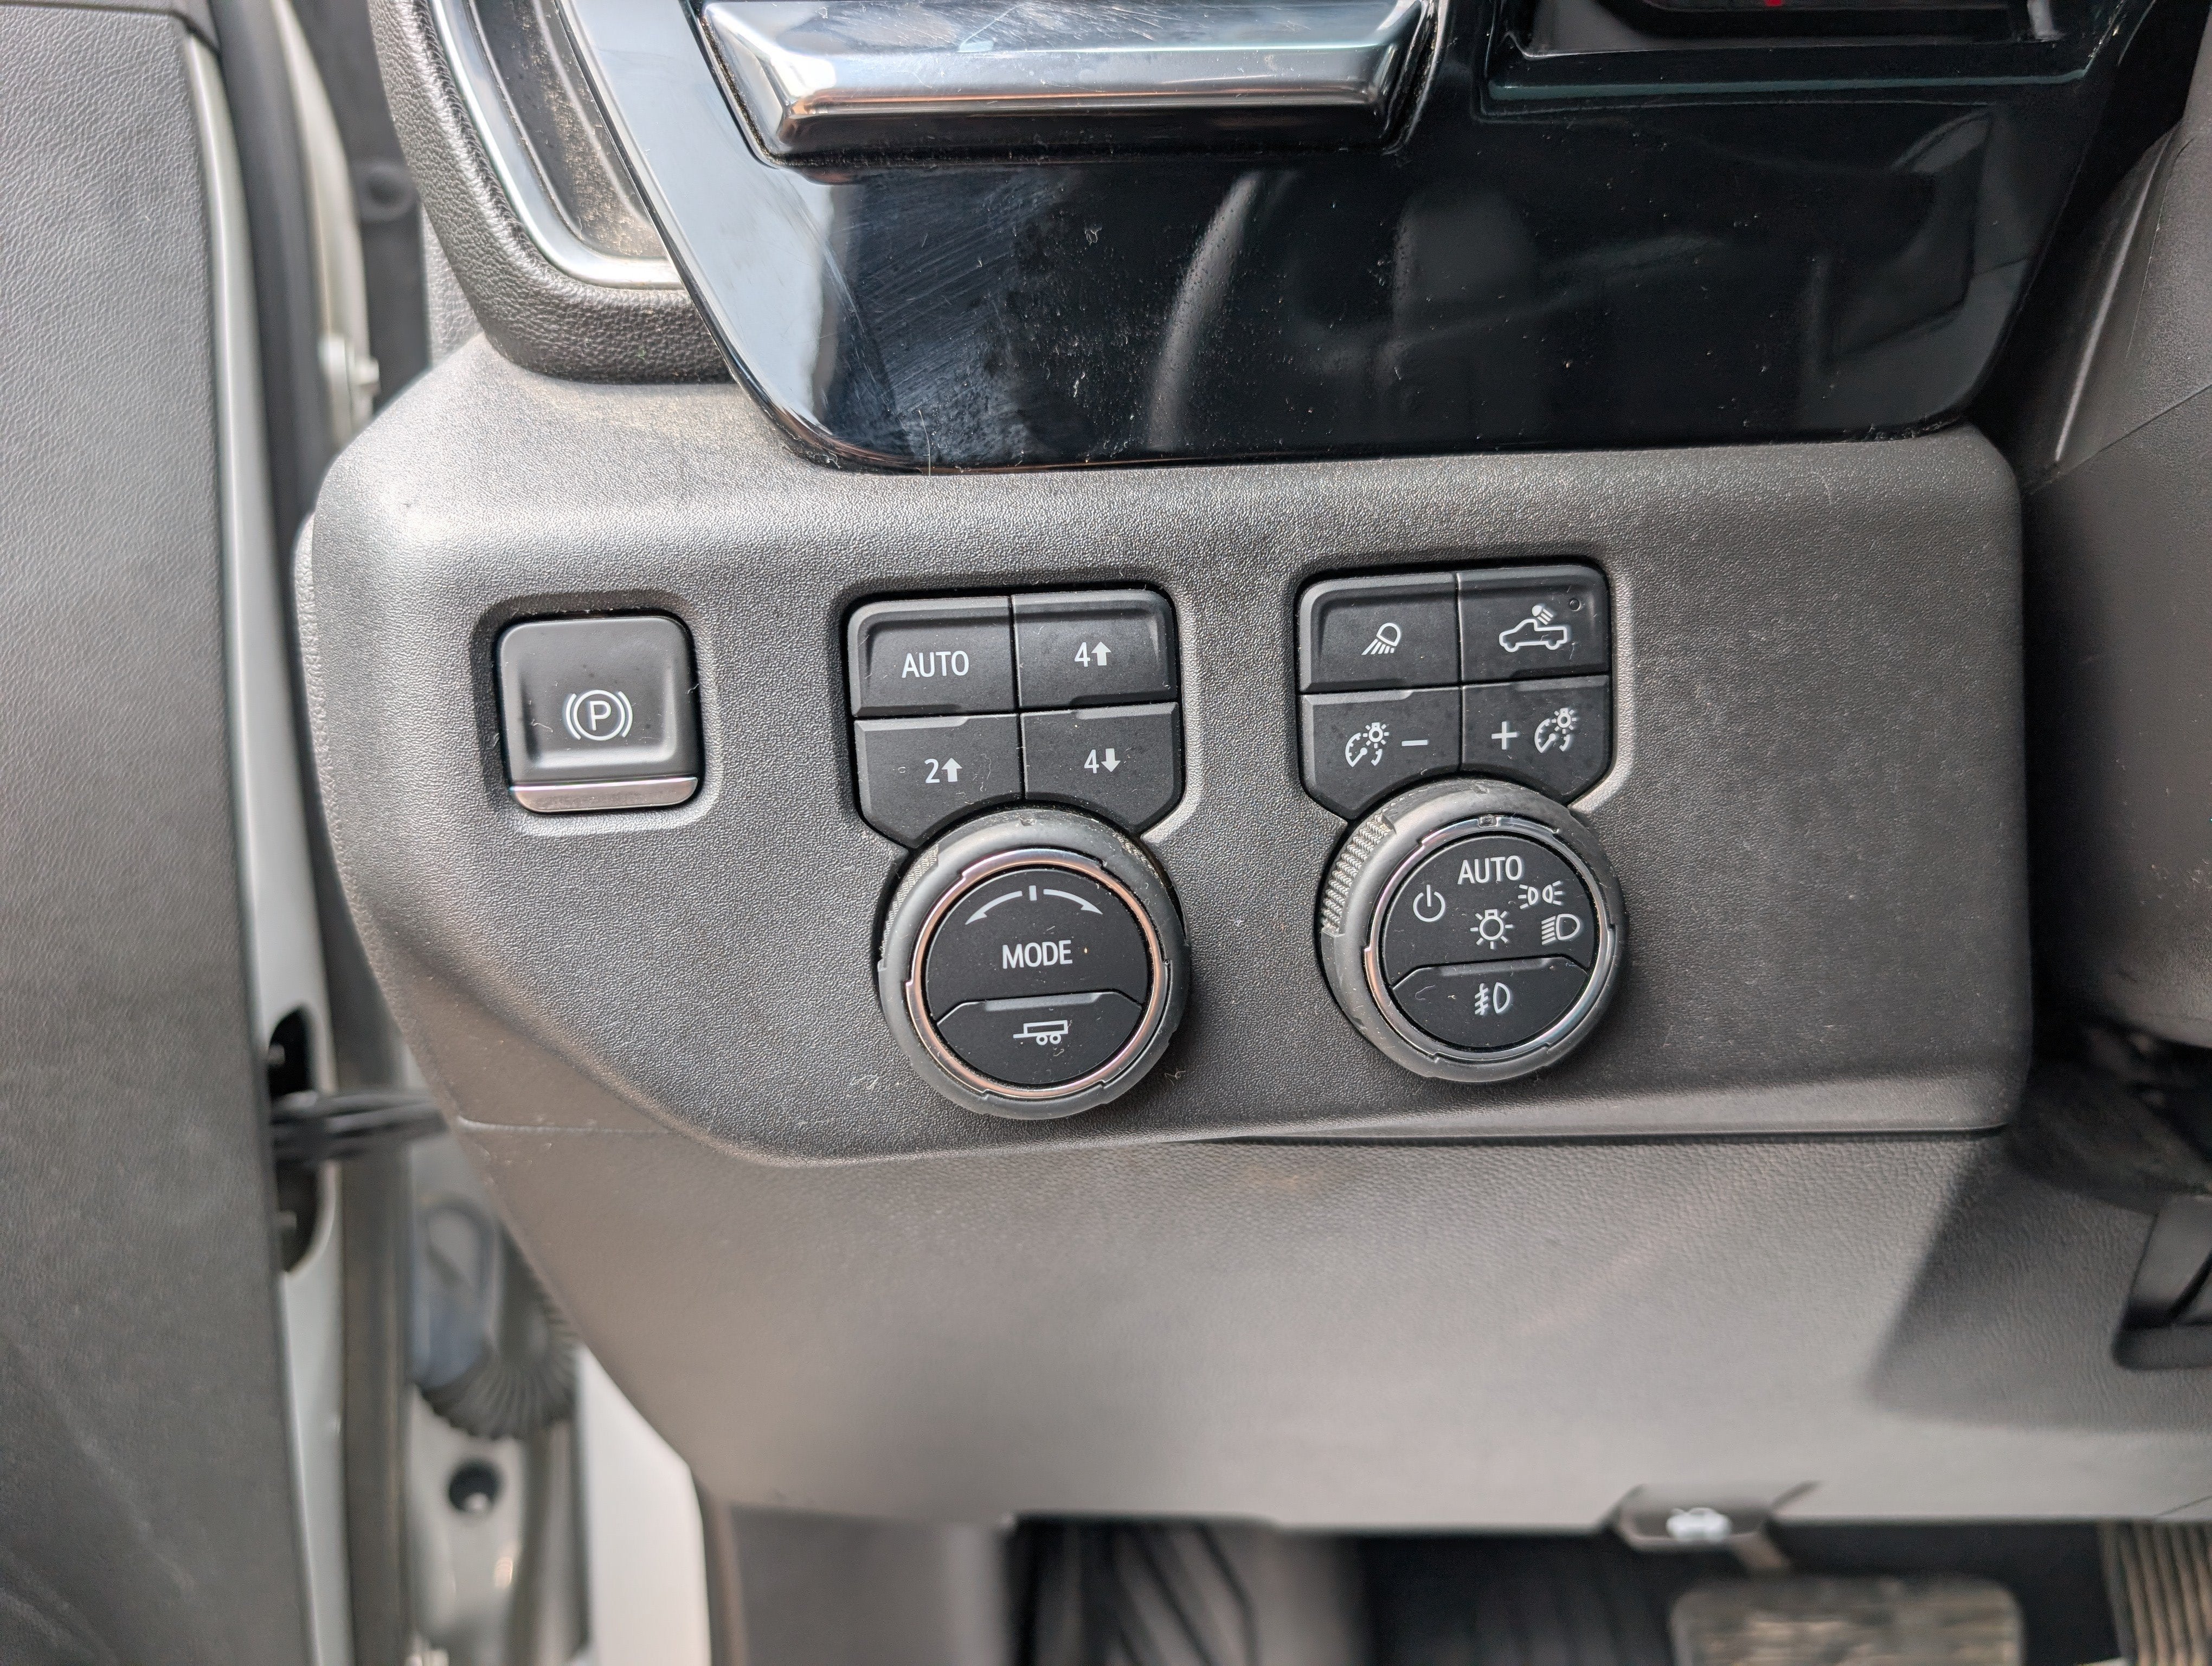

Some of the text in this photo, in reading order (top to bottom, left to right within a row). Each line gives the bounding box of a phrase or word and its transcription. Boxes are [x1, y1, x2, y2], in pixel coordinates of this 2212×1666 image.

[901, 651, 969, 678] AUTO
[1074, 642, 1091, 667] 4
[589, 700, 612, 731] P
[924, 758, 941, 784] 2
[1084, 748, 1099, 774] 4
[1457, 855, 1522, 885] AUTO
[1001, 939, 1073, 969] MODE
